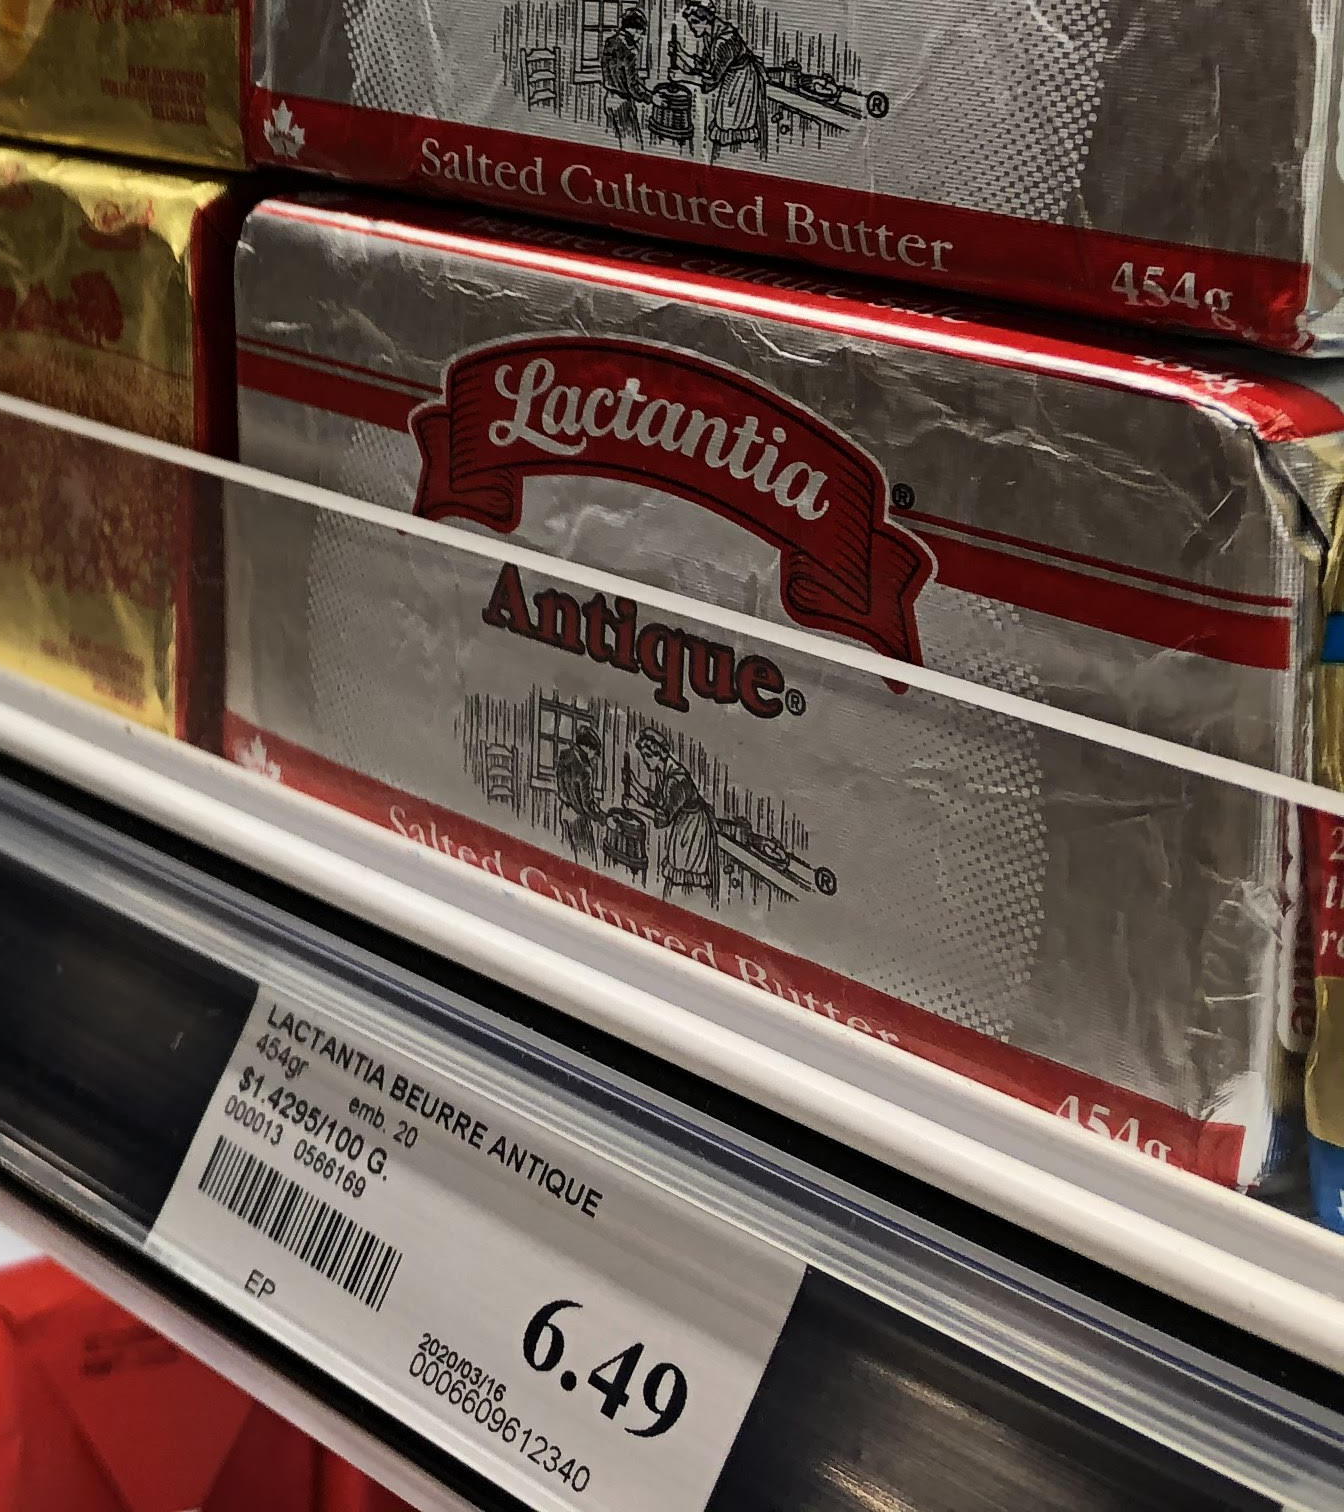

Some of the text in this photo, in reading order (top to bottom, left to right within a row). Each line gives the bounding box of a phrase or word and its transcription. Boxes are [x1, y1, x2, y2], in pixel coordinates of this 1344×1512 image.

[419, 136, 955, 274] Salted Cultured Butter
[1110, 260, 1238, 332] 454g
[487, 357, 831, 522] Lactantia
[482, 562, 785, 720] Antique
[255, 1031, 310, 1082] 454gr
[267, 1003, 604, 1218] LACTANTIA BEURRE ANTIQUE
[223, 1094, 368, 1200] 000013 0566169
[238, 1065, 392, 1183] $1.4295/100 G.
[348, 1095, 419, 1150] emb. 20
[244, 1268, 277, 1300] EP
[408, 1351, 592, 1493] 0006609612340
[418, 1332, 508, 1403] 2020/03/16
[522, 1298, 689, 1439] 6.49
